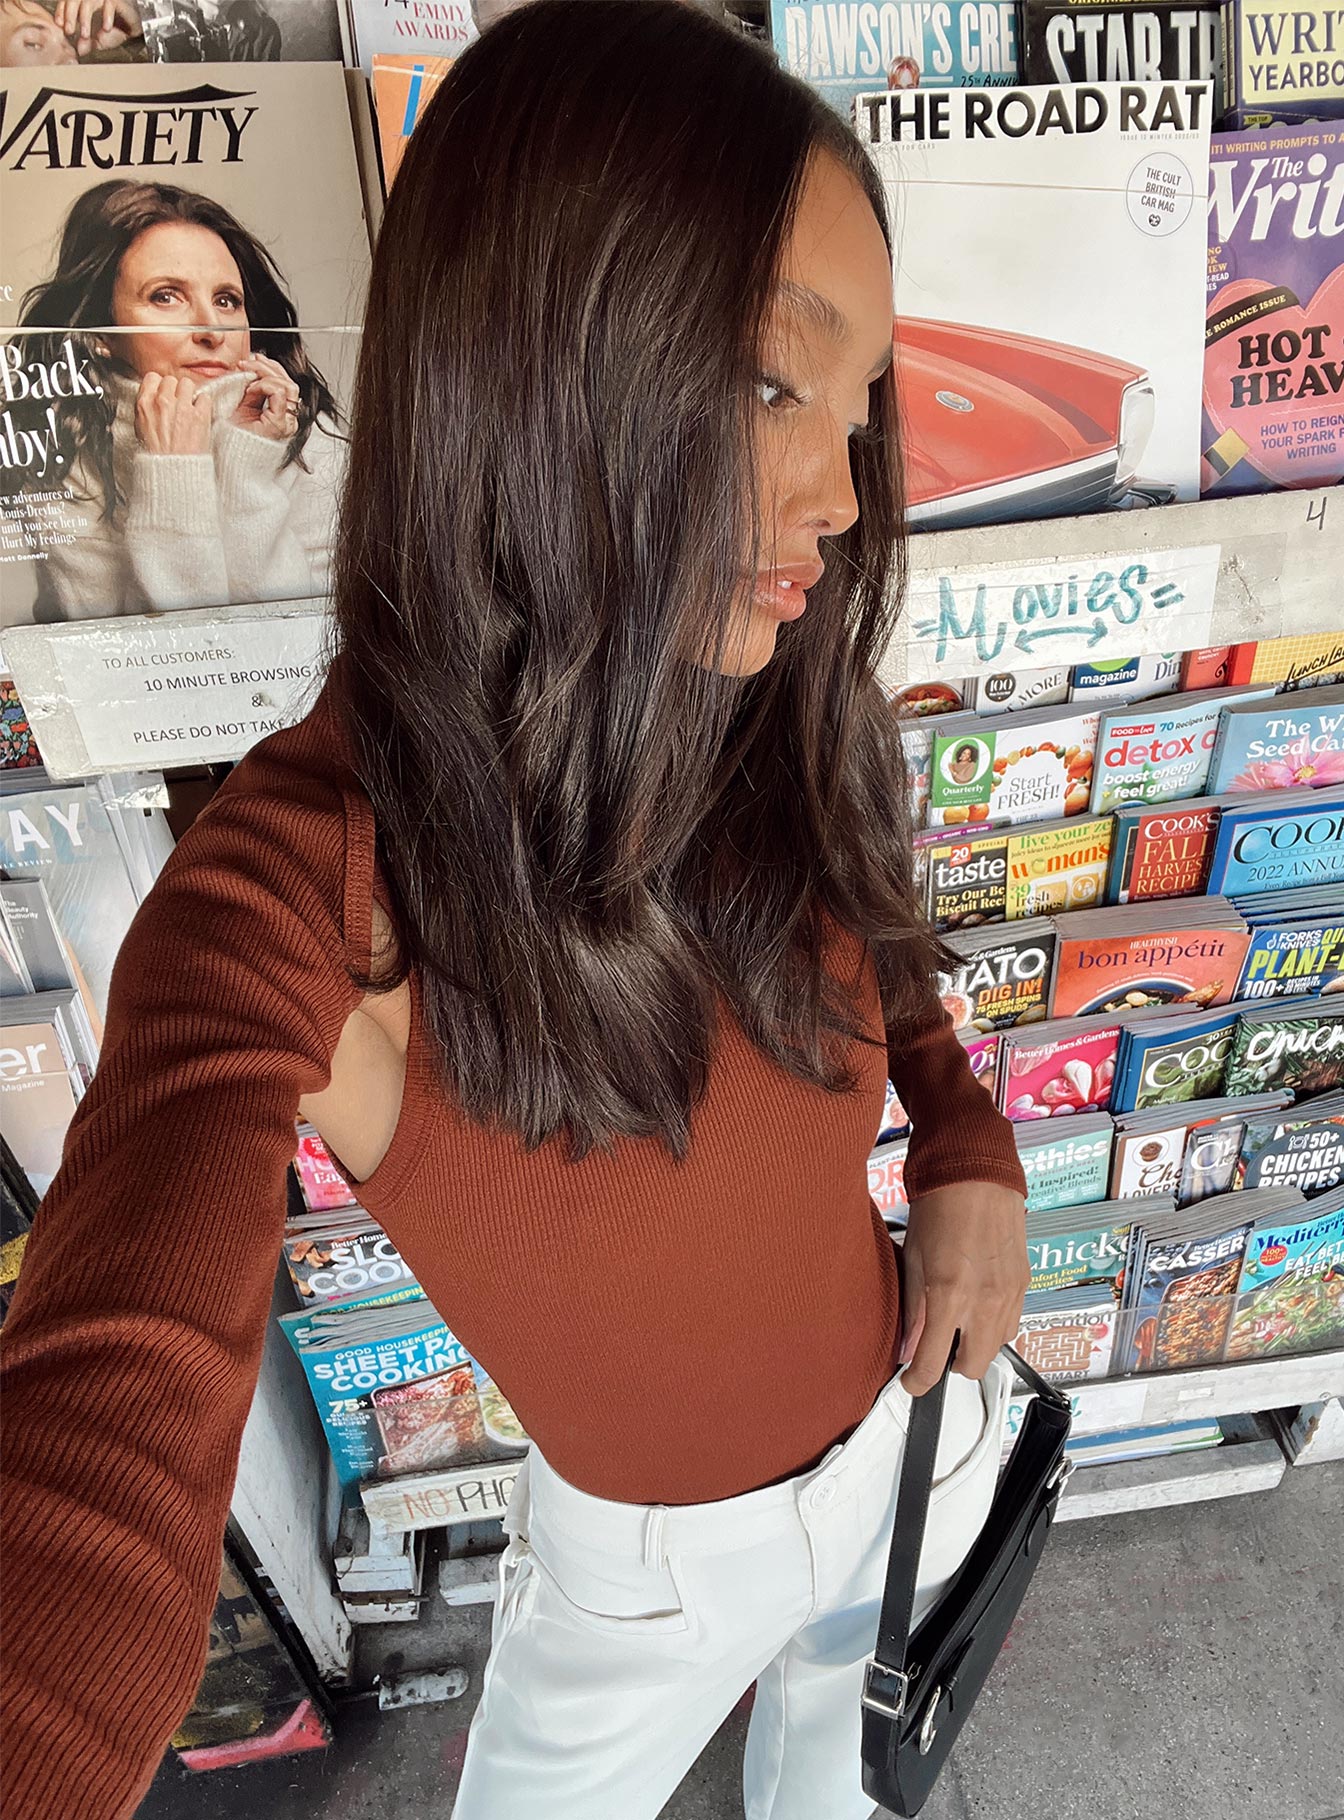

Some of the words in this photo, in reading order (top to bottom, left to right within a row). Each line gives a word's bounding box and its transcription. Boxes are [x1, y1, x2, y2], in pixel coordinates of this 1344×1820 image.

[413, 2, 465, 22] EMMY
[393, 19, 468, 41] AWARDS
[785, 2, 953, 77] DAWSON'S
[1046, 12, 1162, 83] STAR
[862, 90, 950, 144] THE
[965, 87, 1108, 139] ROAD
[1120, 85, 1208, 132] RAT
[0, 83, 259, 170] VARIETY
[1225, 140, 1267, 154] WRITING
[1270, 136, 1319, 149] PROMPTS
[1323, 134, 1334, 144] TO
[1146, 167, 1161, 180] THE
[1162, 170, 1181, 186] CULT
[1271, 156, 1303, 179] The
[1145, 182, 1177, 199] BRITISH
[1141, 194, 1156, 209] CAR
[1157, 198, 1175, 213] MAG
[1214, 305, 1258, 333] ROMANCE
[1259, 294, 1287, 311] ISSUE
[1237, 324, 1331, 370] HOT
[1260, 422, 1289, 437] HOW
[1292, 420, 1307, 432] TO
[1261, 435, 1293, 450] YOUR
[1297, 431, 1336, 446] SPARK
[1286, 442, 1337, 460] WRITING
[13, 489, 62, 505] adventures
[65, 486, 74, 499] of
[1306, 497, 1327, 530] 4
[1, 519, 23, 535] until
[24, 520, 42, 536] you
[102, 658, 121, 670] TO
[126, 656, 145, 668] ALL
[151, 649, 236, 665] CUSTOMERS:
[144, 679, 163, 692] 10
[167, 673, 227, 690] MINUTE
[231, 665, 312, 684] BROWSING
[988, 678, 1013, 692] 100
[1079, 665, 1137, 686] magazine
[1017, 672, 1063, 705] MORE
[1111, 727, 1134, 737] FOOD
[1159, 721, 1174, 732] 70
[1175, 715, 1204, 731] Recipes
[1205, 712, 1217, 722] for
[1265, 719, 1312, 738] The
[133, 728, 186, 744] PLEASE
[190, 724, 212, 738] DO
[216, 722, 247, 736] NOT
[1104, 732, 1195, 768] detox
[1246, 738, 1307, 758] Seed
[1009, 772, 1053, 793] Start
[1102, 768, 1150, 787] boost
[1151, 758, 1201, 780] energy
[942, 784, 984, 797] Quarterly
[997, 784, 1060, 810] FRESH!
[1113, 785, 1145, 799] feel
[1146, 776, 1188, 797] great!
[1144, 811, 1220, 840] COOK'S
[1020, 833, 1050, 850] live
[1054, 826, 1091, 842] your
[951, 846, 970, 861] 20
[936, 857, 1006, 888] taste
[1247, 863, 1285, 883] 2022
[1287, 853, 1344, 876] ANNU
[936, 893, 959, 908] Try
[962, 888, 987, 901] Our
[1015, 889, 1050, 909] fresh
[936, 900, 978, 918] Biscuit
[1279, 929, 1322, 942] FORKS
[1280, 939, 1320, 950] KNIVES
[984, 945, 1017, 957] Gardens
[1077, 950, 1128, 969] bon
[1134, 938, 1227, 967] appétit
[1247, 944, 1344, 979] PLANT-
[978, 984, 1012, 1006] DIG
[1016, 978, 1043, 997] IN!
[1243, 979, 1285, 999] 100+
[976, 1005, 986, 1015] 75
[987, 998, 1015, 1011] FRESH
[1016, 993, 1042, 1006] SPINS
[986, 1009, 999, 1018] ON
[1000, 1003, 1029, 1016] SPUDS
[1015, 1047, 1043, 1060] Better
[1045, 1042, 1075, 1055] Homes
[1082, 1029, 1120, 1044] Gardens
[1, 1079, 45, 1093] Magazine
[1309, 1130, 1340, 1148] 50+
[1260, 1149, 1344, 1176] CHICKEN
[1039, 1165, 1099, 1188] Inspired!
[1067, 1174, 1102, 1189] Blends
[1149, 1235, 1246, 1273] CASSER
[1284, 1252, 1315, 1272] EAT
[1060, 1264, 1088, 1277] Food
[1295, 1260, 1328, 1281] FEEL
[313, 1343, 419, 1379] SHEET
[335, 1346, 372, 1361] GOOD
[329, 1398, 368, 1414] 75+
[403, 1489, 450, 1520] NO
